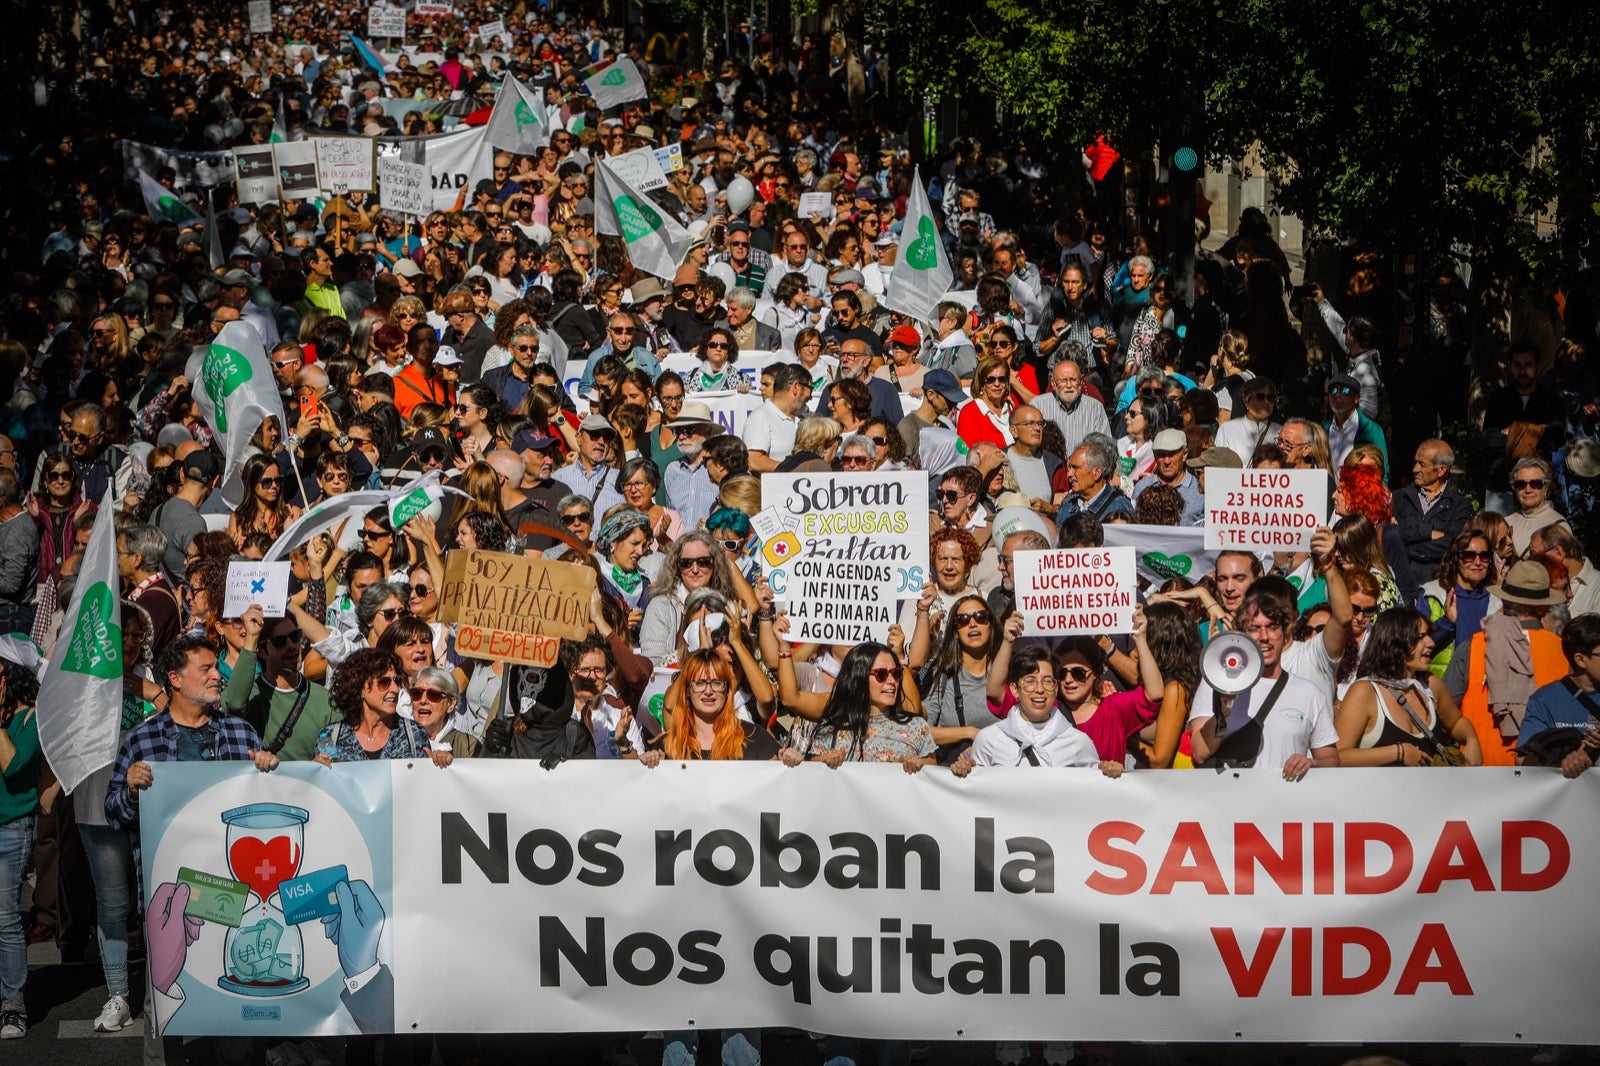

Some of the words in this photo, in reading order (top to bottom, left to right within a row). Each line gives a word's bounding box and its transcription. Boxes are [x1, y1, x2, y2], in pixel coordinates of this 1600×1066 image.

[1241, 473, 1290, 488] LLEVO
[784, 478, 909, 515] Sobran
[1227, 492, 1245, 506] 23
[1250, 493, 1304, 508] HORAS
[804, 511, 909, 536] EXCUSAS
[1210, 510, 1320, 529] TRABAJANDO,
[803, 535, 911, 561] Faltan
[1251, 530, 1302, 545] CURO?
[467, 551, 514, 583] SOY
[524, 565, 553, 593] LA
[794, 561, 822, 578] CON
[826, 563, 891, 583] AGENDAS
[1038, 551, 1111, 572] ¡MÉDIC@S
[802, 581, 879, 601] INFINITAS
[1032, 572, 1119, 590] LUCHANDO,
[443, 578, 588, 628] PRIVATIZACIÓN
[1022, 591, 1079, 610] TAMBIÉN
[1088, 588, 1131, 608] ESTÁN
[789, 600, 808, 618] LA
[814, 602, 890, 623] PRIMARIA
[1036, 612, 1118, 630] CURANDO!
[81, 611, 102, 669] PÚBLICA
[90, 597, 117, 662] SANIDAD
[800, 622, 877, 642] AGONIZA.
[73, 634, 82, 670] 100%
[457, 626, 483, 651] OS
[488, 630, 558, 666] ESPERO
[441, 813, 624, 886] Nos
[655, 813, 940, 890] roban
[975, 818, 1054, 894] la
[1088, 820, 1570, 894] SANIDAD
[285, 882, 314, 900] VISA
[539, 916, 725, 987] Nos
[754, 918, 1065, 1005] quitan
[1100, 924, 1180, 996] la
[1210, 923, 1474, 998] VIDA
